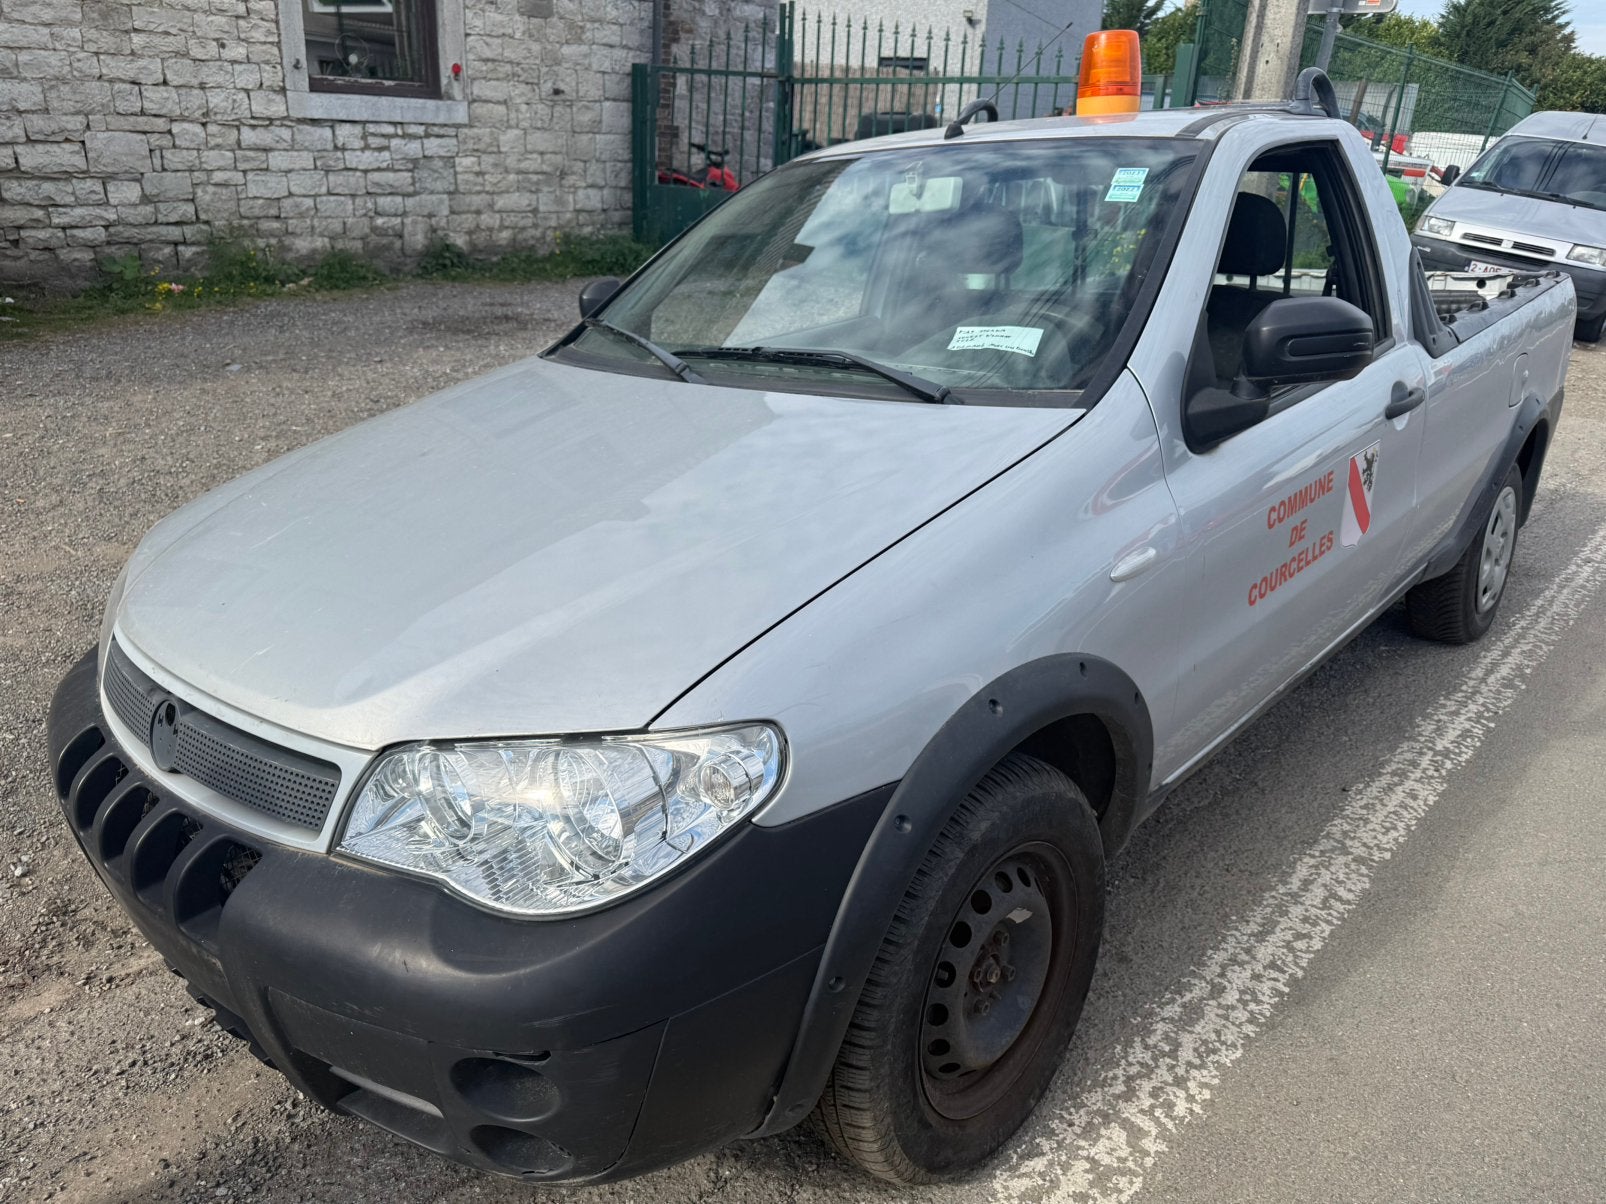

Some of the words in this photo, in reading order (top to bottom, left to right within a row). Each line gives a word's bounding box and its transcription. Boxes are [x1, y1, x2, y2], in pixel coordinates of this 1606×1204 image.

[1267, 470, 1334, 530] COMMUNE
[1288, 518, 1308, 548] DE
[1247, 530, 1334, 607] COURCELLES
